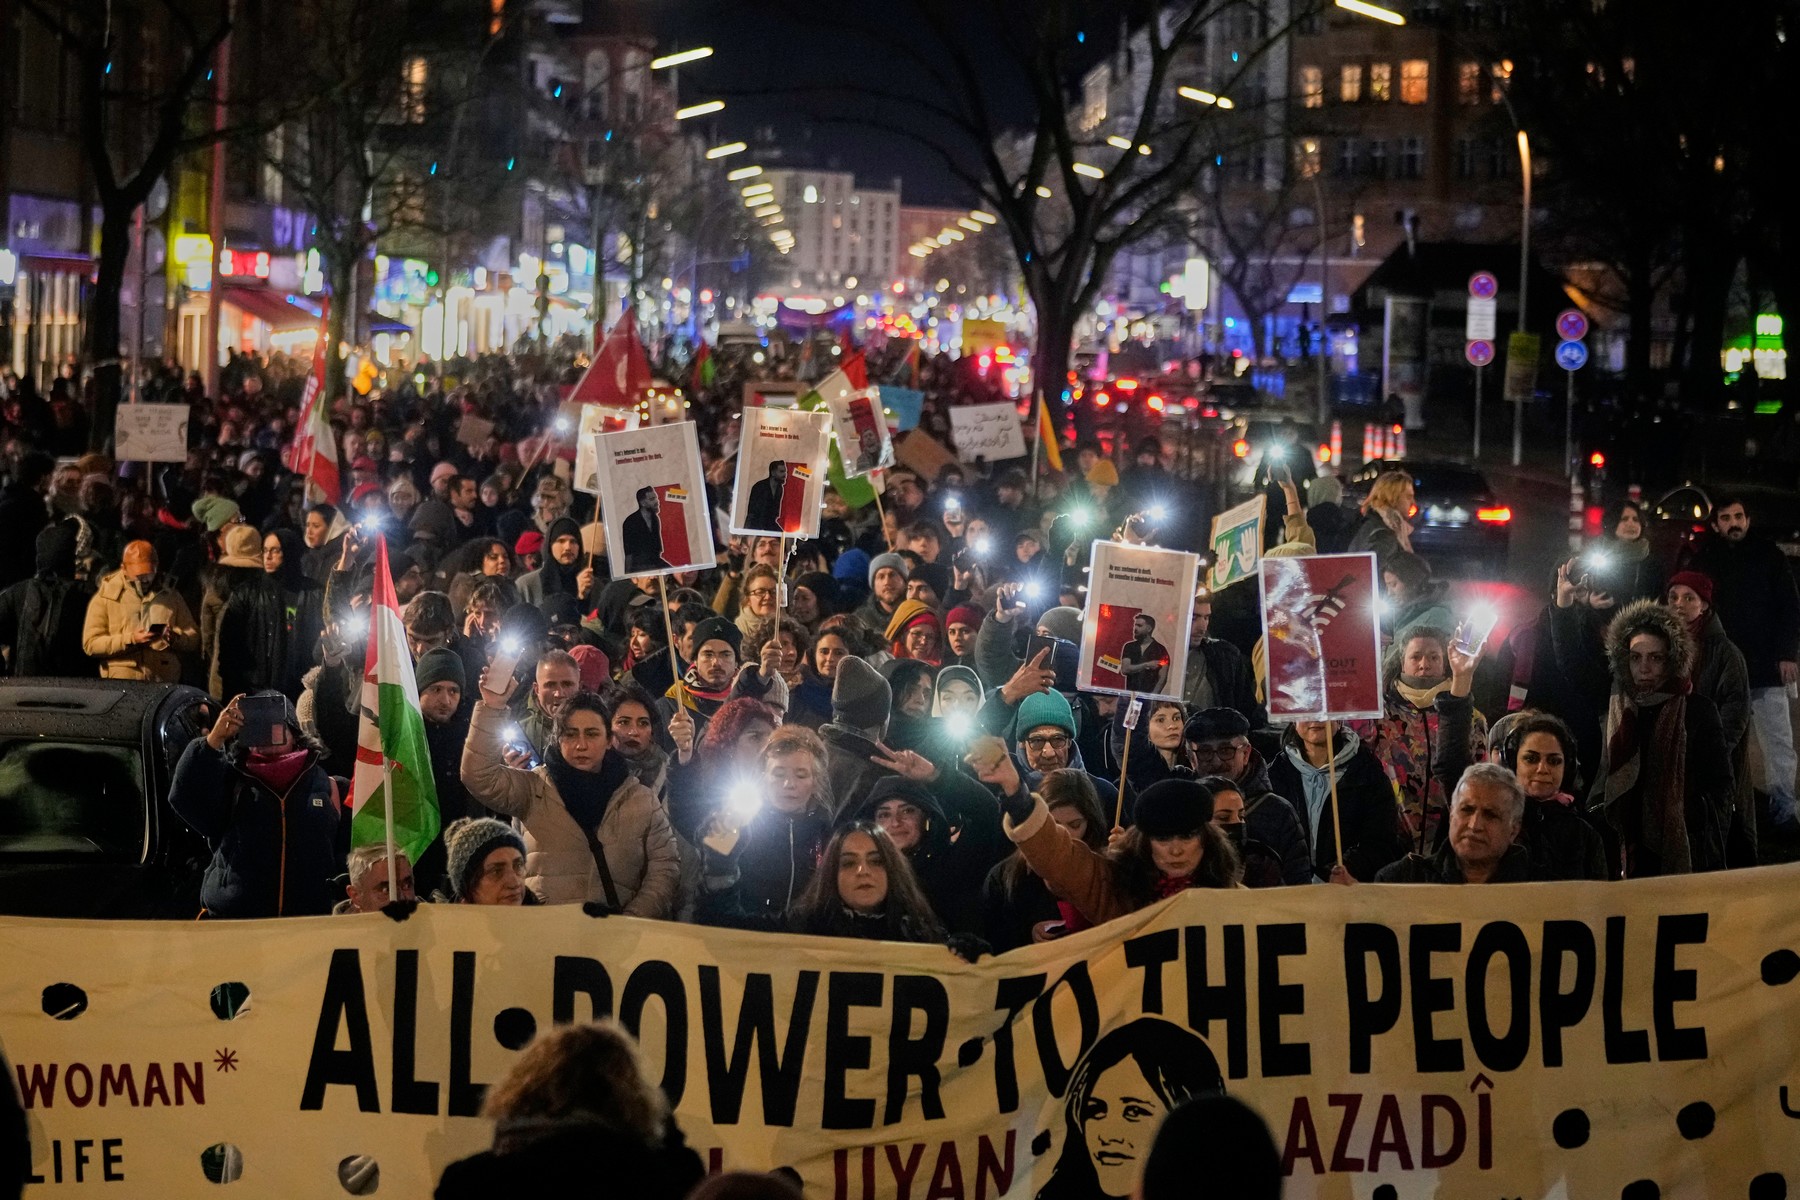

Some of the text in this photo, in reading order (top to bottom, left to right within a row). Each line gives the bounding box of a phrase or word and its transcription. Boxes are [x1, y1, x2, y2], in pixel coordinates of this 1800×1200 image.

[300, 948, 487, 1117] ALL
[992, 959, 1100, 1115] TO
[1123, 922, 1312, 1080] THE
[1344, 912, 1709, 1075] PEOPLE
[24, 1138, 125, 1184] LIFE
[1280, 1072, 1495, 1177] AZADÎ
